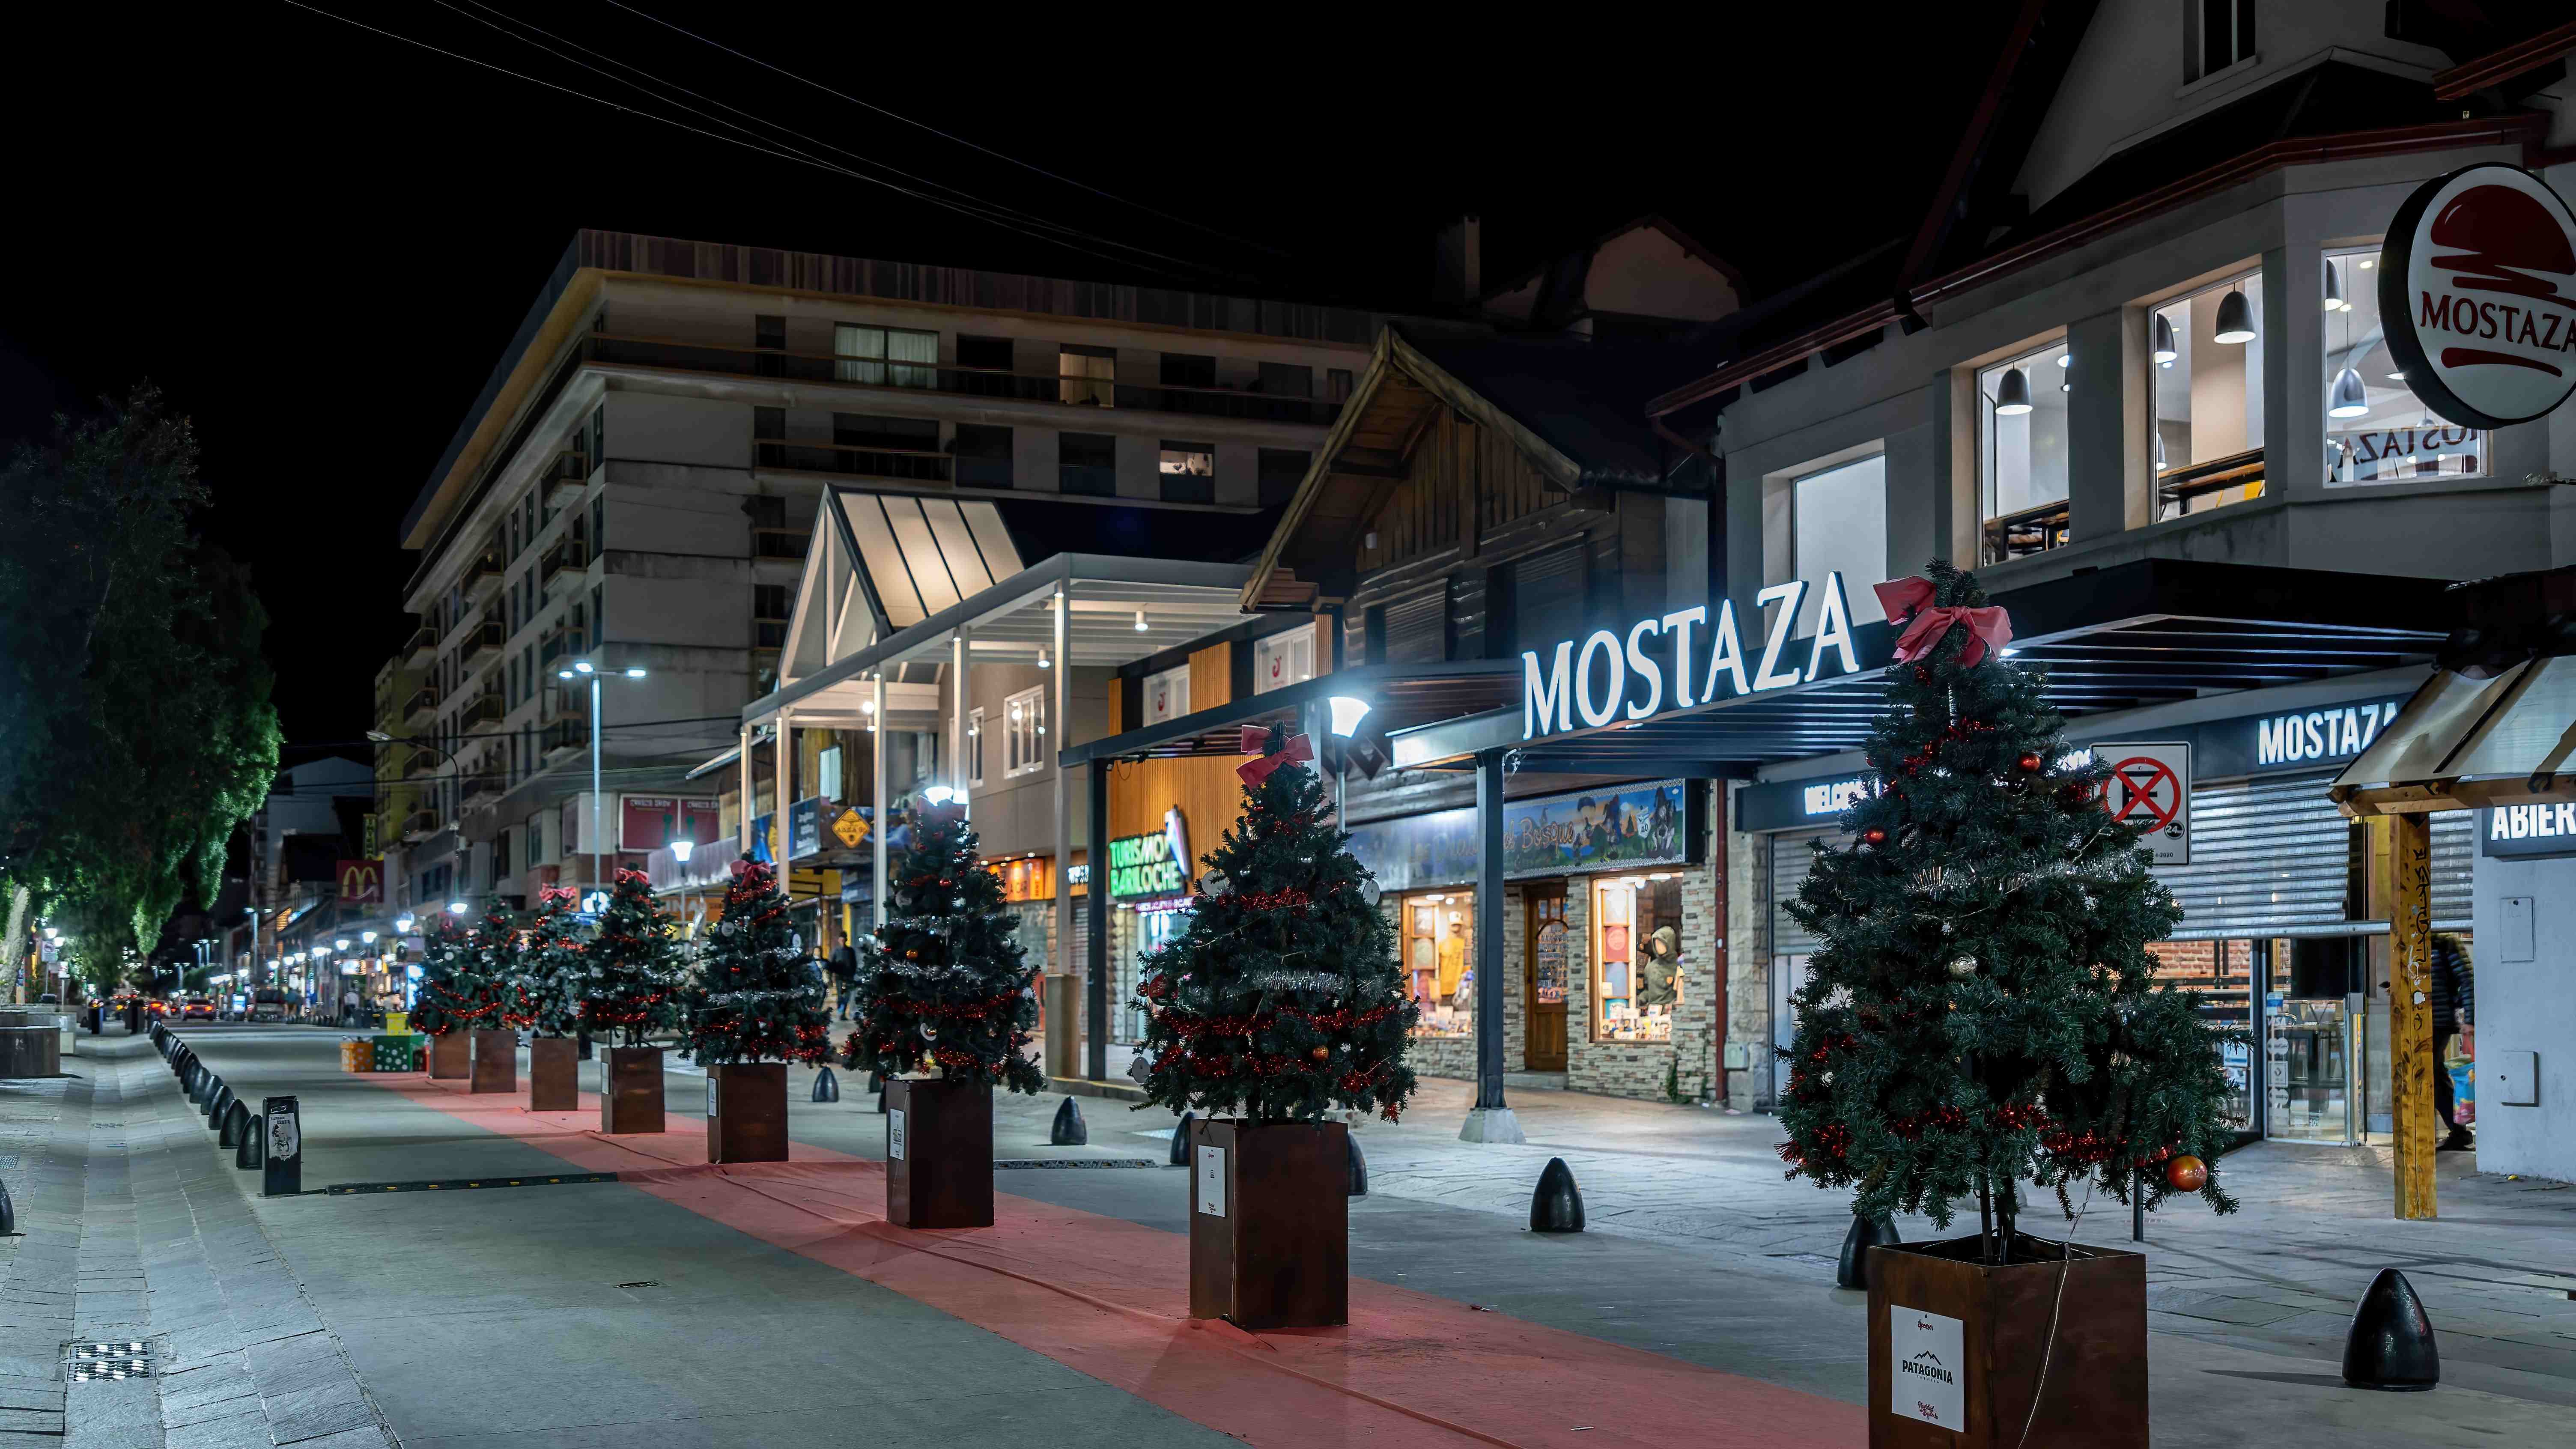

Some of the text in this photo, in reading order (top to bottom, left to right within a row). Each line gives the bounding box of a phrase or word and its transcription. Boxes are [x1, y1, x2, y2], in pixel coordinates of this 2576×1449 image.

[1522, 571, 1860, 740] MOSTAZA
[1109, 834, 1164, 868] TURISMO
[1110, 860, 1179, 897] BARILOCHE
[1902, 1360, 1953, 1385] PATAGONIA
